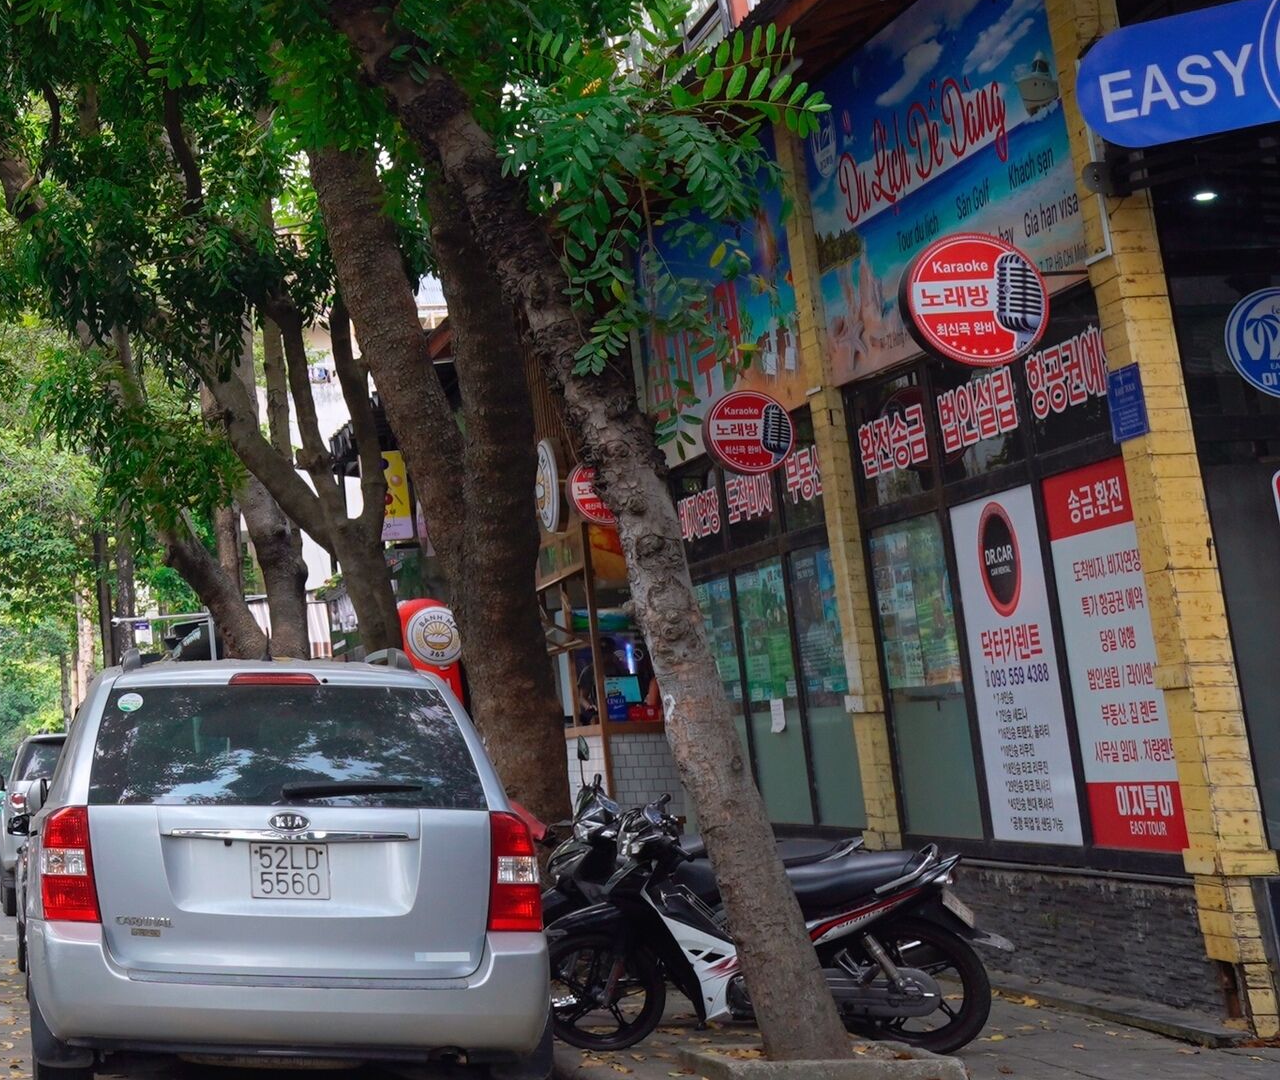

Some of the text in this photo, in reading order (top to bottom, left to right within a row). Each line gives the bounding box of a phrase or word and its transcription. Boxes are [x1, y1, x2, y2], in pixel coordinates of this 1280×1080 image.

[1098, 43, 1253, 123] EASY
[941, 75, 1008, 163] Dàng
[1007, 146, 1054, 191] Khách sạn
[973, 177, 990, 211] Golf
[1024, 190, 1079, 238] Gia hạn visa
[896, 213, 939, 253] Tour du lịch
[932, 259, 988, 274] Karaoke
[921, 284, 989, 308] 노래방
[936, 320, 996, 337] 최신곡 완비
[724, 407, 759, 416] Karaoke
[858, 325, 1108, 479] 환전송금 법인설립 항공권예
[716, 422, 758, 437] 노래방
[724, 472, 773, 525] 도착비자
[985, 544, 1014, 566] DR.CAR
[1107, 549, 1141, 576] 비자연장
[1081, 586, 1144, 617] 특가 항공권 예약
[981, 623, 1043, 664] 닥터카렌트
[1100, 626, 1137, 652] 당일 여행
[991, 669, 1007, 688] 093
[1009, 666, 1025, 685] 559
[1027, 663, 1049, 683] 4388
[1087, 666, 1120, 691] 법인설립
[1126, 662, 1157, 687] 라이센
[1129, 702, 1139, 724] 집
[1140, 700, 1159, 724] 렌트
[1095, 741, 1120, 763] 사무실
[1120, 739, 1139, 762] 임대
[1115, 784, 1175, 817] 이지투어
[276, 814, 303, 828] KIA
[1130, 820, 1168, 836] EASY TOUR
[256, 845, 320, 870] 52LD
[261, 871, 320, 895] 5560
